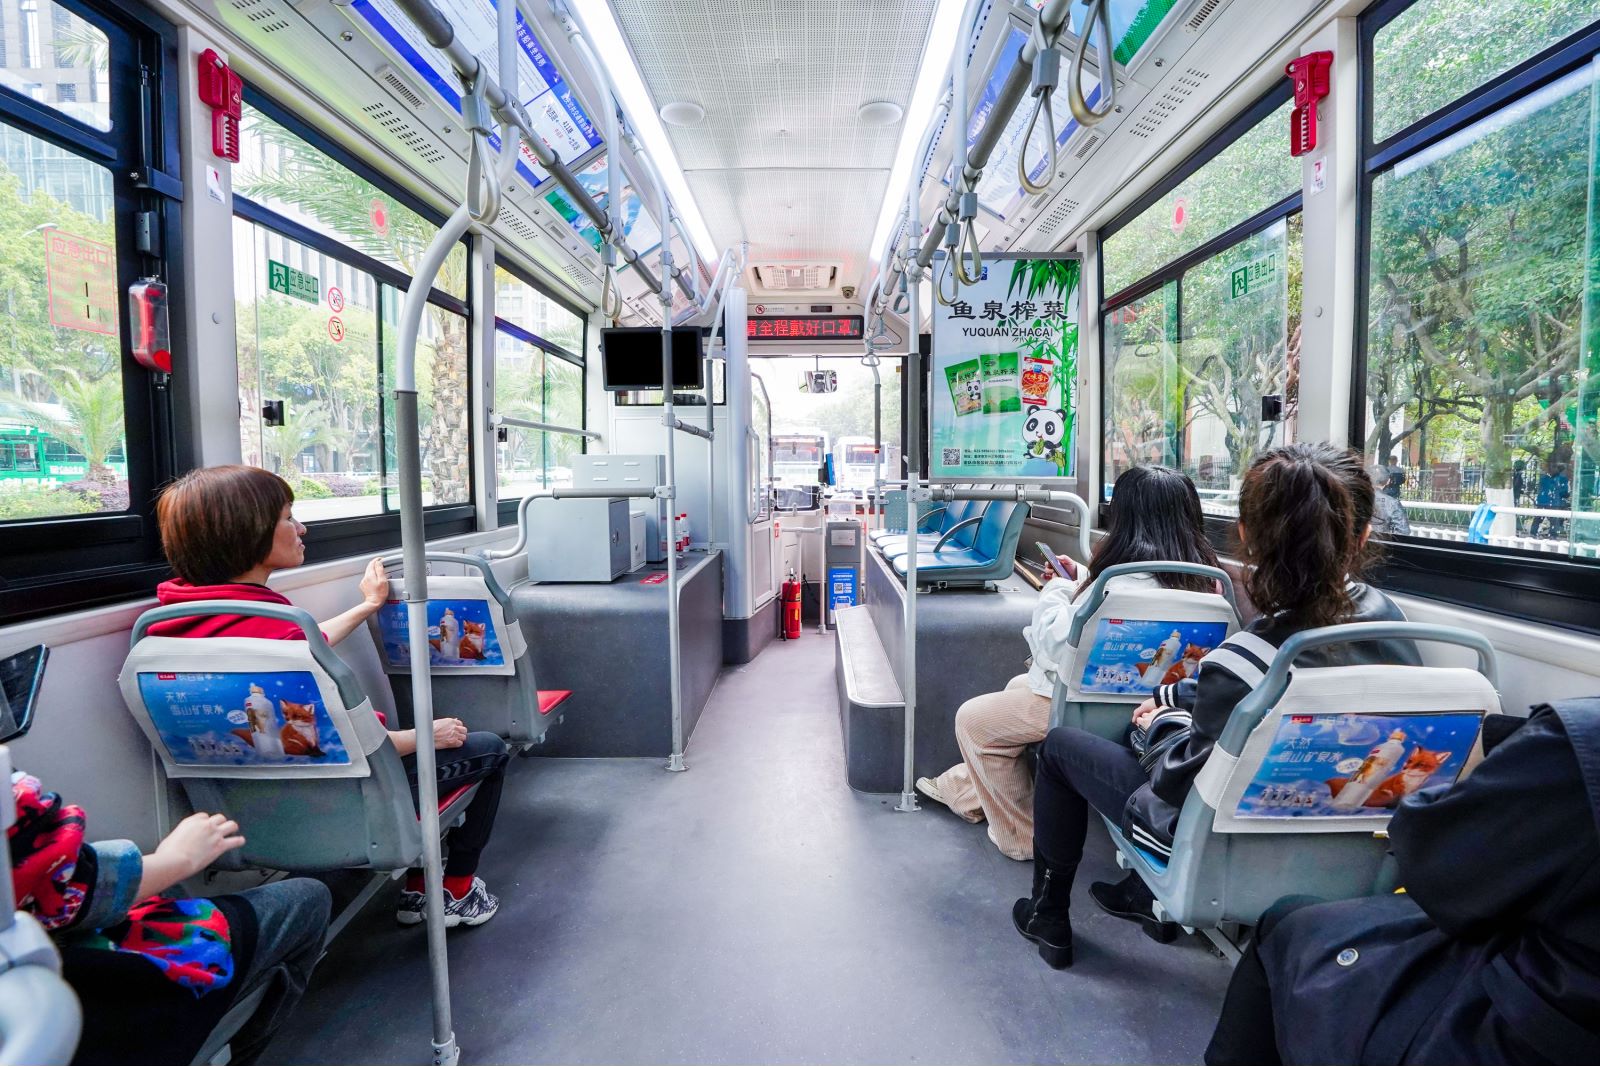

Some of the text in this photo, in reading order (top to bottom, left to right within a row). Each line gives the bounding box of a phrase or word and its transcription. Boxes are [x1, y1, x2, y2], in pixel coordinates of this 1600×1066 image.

[1249, 254, 1275, 281] 应急出口
[290, 268, 318, 294] 应急出口
[948, 300, 1069, 321] 鱼泉榨菜
[962, 327, 1053, 337] YUQUAN ZHACAI
[165, 691, 187, 703] 天然
[1283, 737, 1313, 749] 天然
